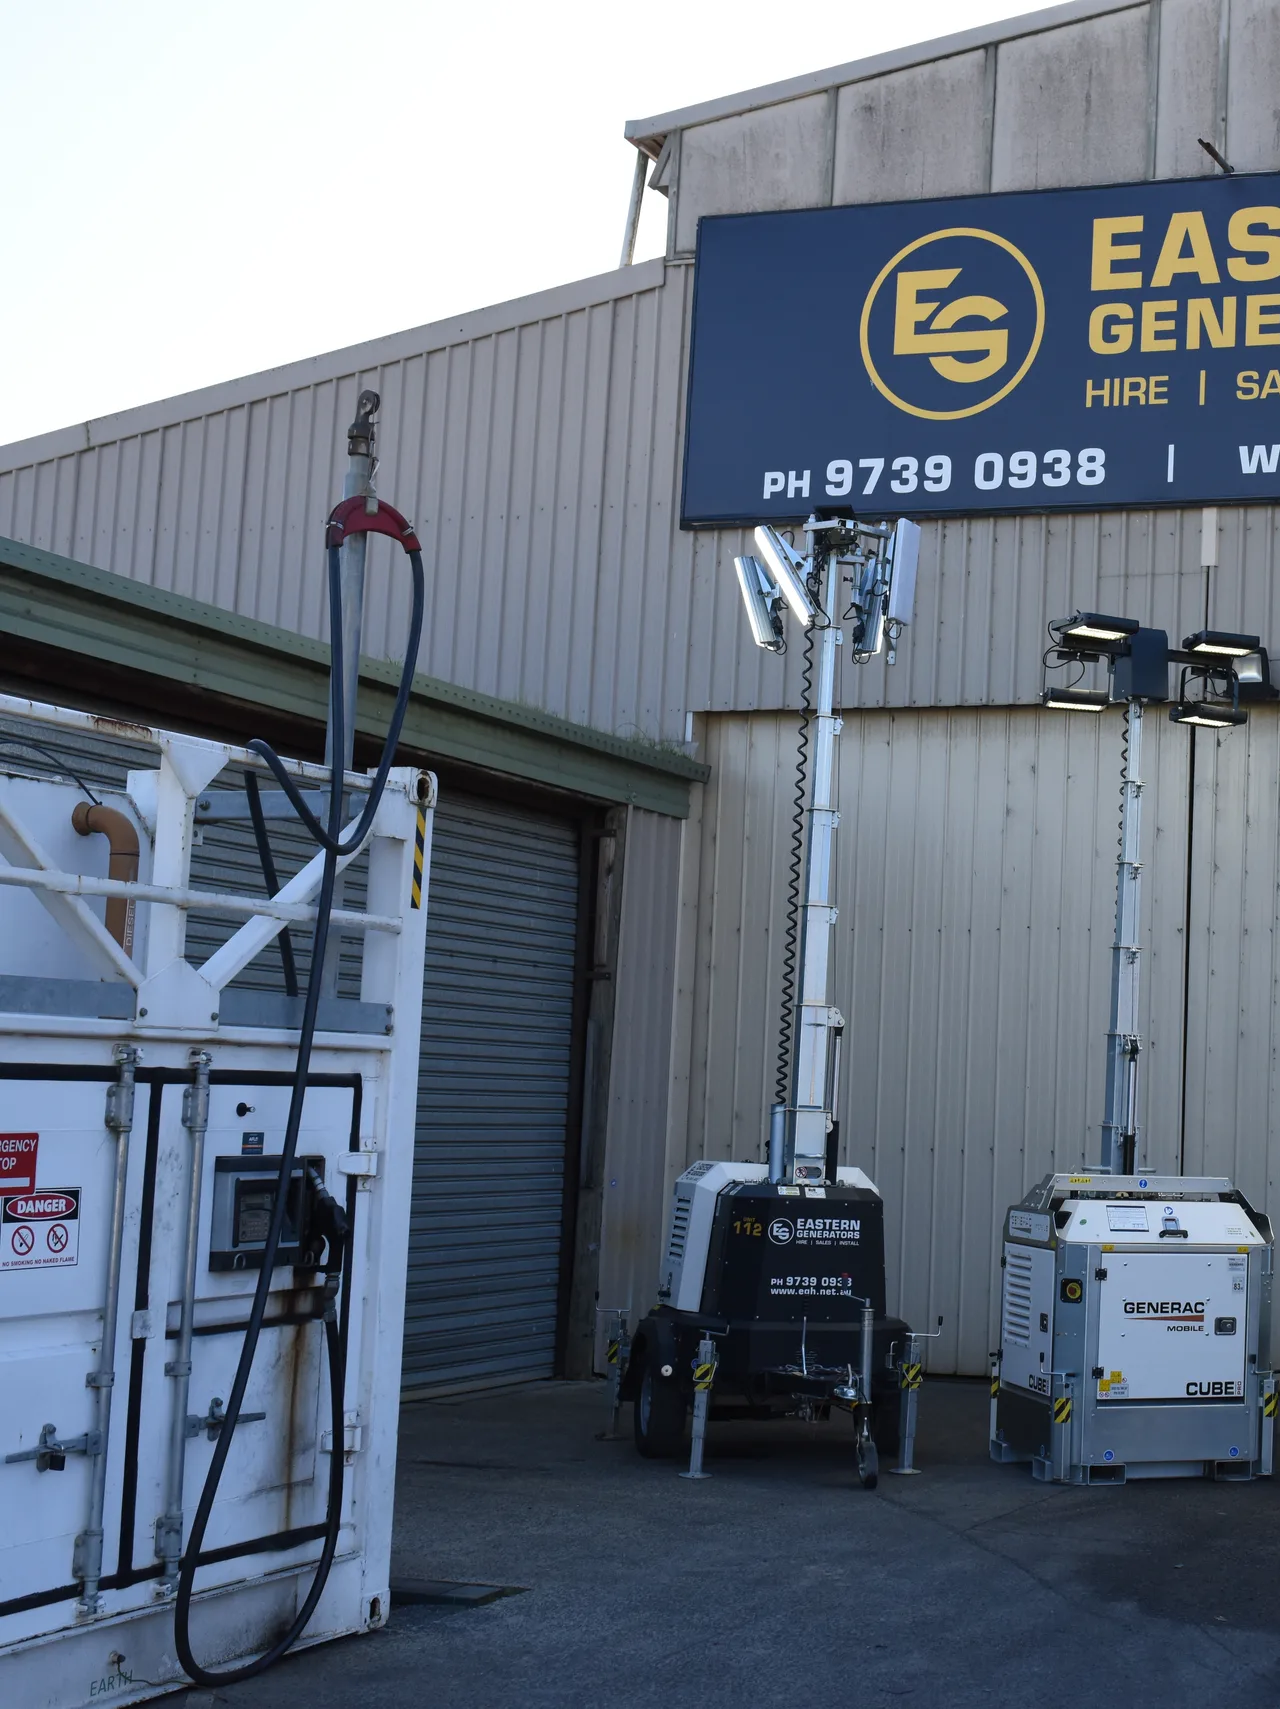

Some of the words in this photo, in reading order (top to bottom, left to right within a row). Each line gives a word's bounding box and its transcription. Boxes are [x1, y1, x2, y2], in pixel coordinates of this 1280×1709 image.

[1085, 375, 1169, 408] HIRE
[762, 469, 811, 499] PH
[825, 454, 952, 497] 9739
[973, 447, 1106, 491] 0938
[0, 1139, 37, 1153] GENCY
[16, 1198, 67, 1214] DANGER
[733, 1221, 762, 1236] 112
[796, 1218, 860, 1230] EASTERN
[796, 1230, 860, 1239] GENERATORS
[11, 1259, 34, 1267] SMOKING
[770, 1278, 783, 1286] PH
[786, 1276, 817, 1287] 9739
[1123, 1301, 1205, 1314] GENERAC
[1029, 1374, 1047, 1393] CUBE
[1185, 1381, 1235, 1396] CUBE
[89, 1669, 134, 1697] EARTH
